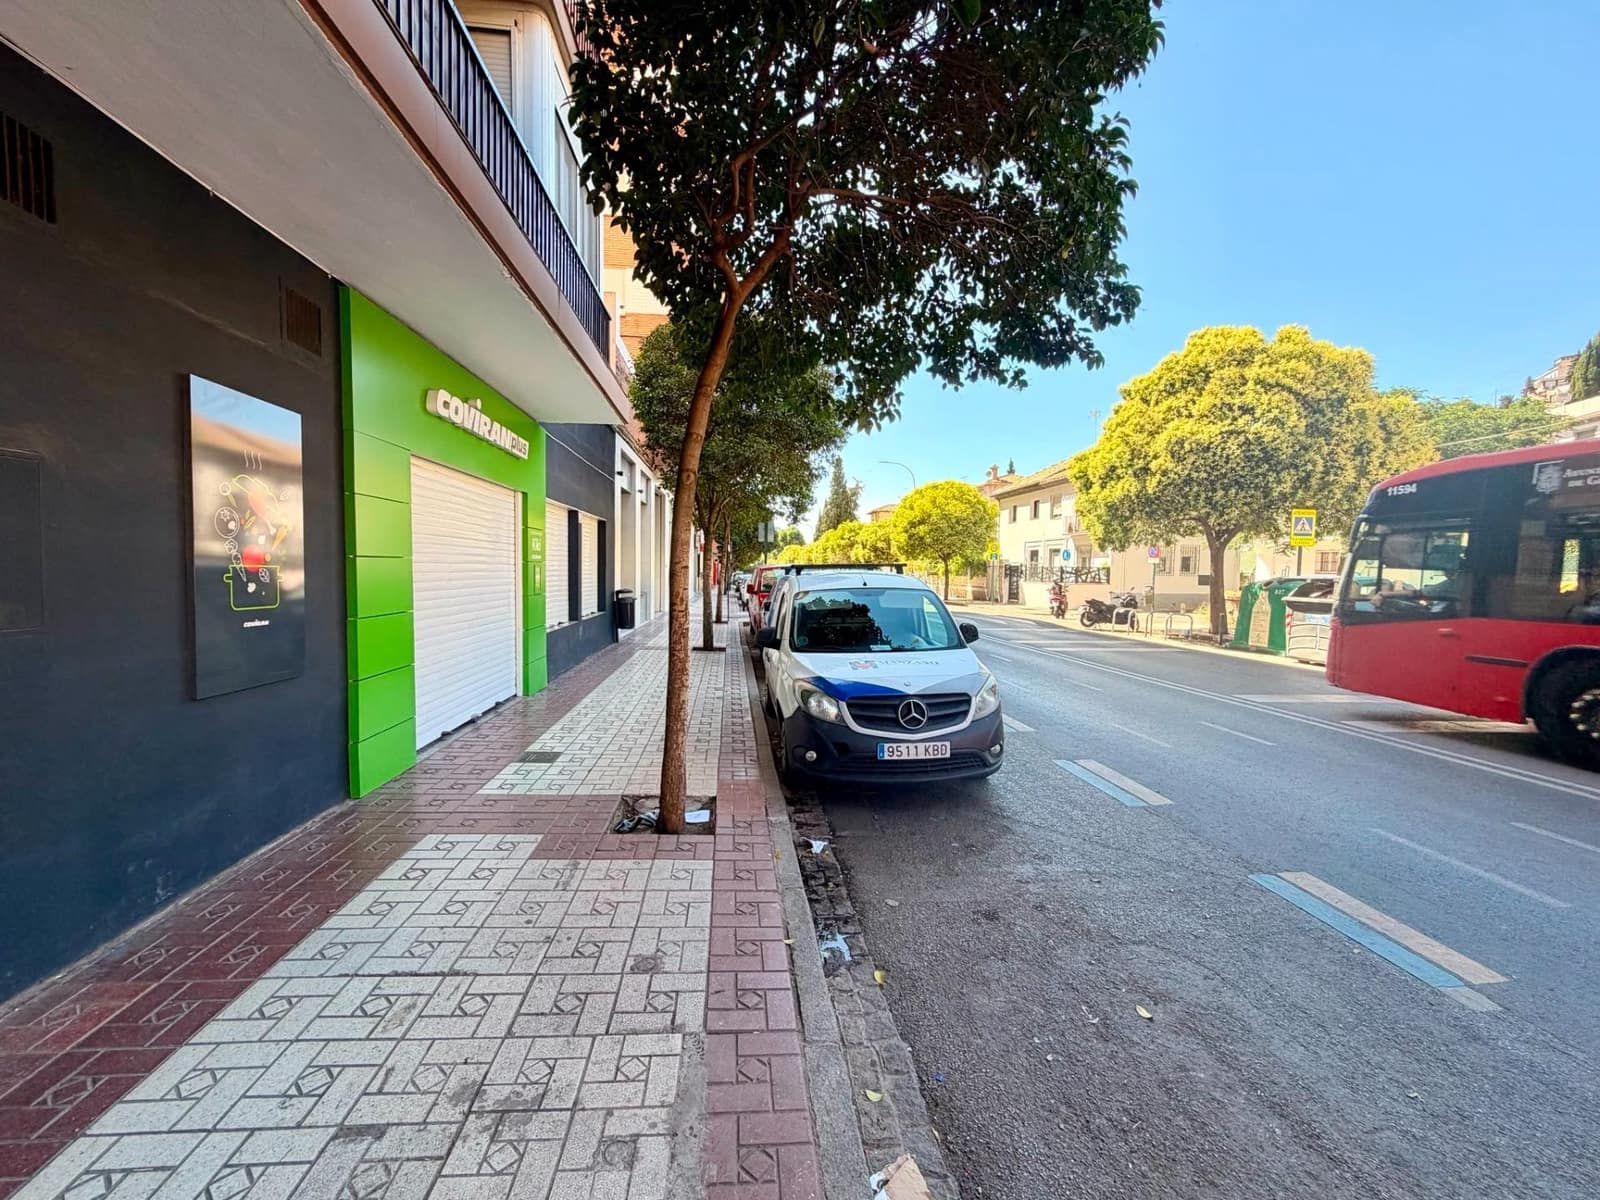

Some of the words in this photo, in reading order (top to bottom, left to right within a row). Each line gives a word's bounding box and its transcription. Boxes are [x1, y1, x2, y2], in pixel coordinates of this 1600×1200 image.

[1387, 483, 1417, 496] 11594
[887, 745, 918, 757] 9511
[924, 744, 948, 757] KBD
